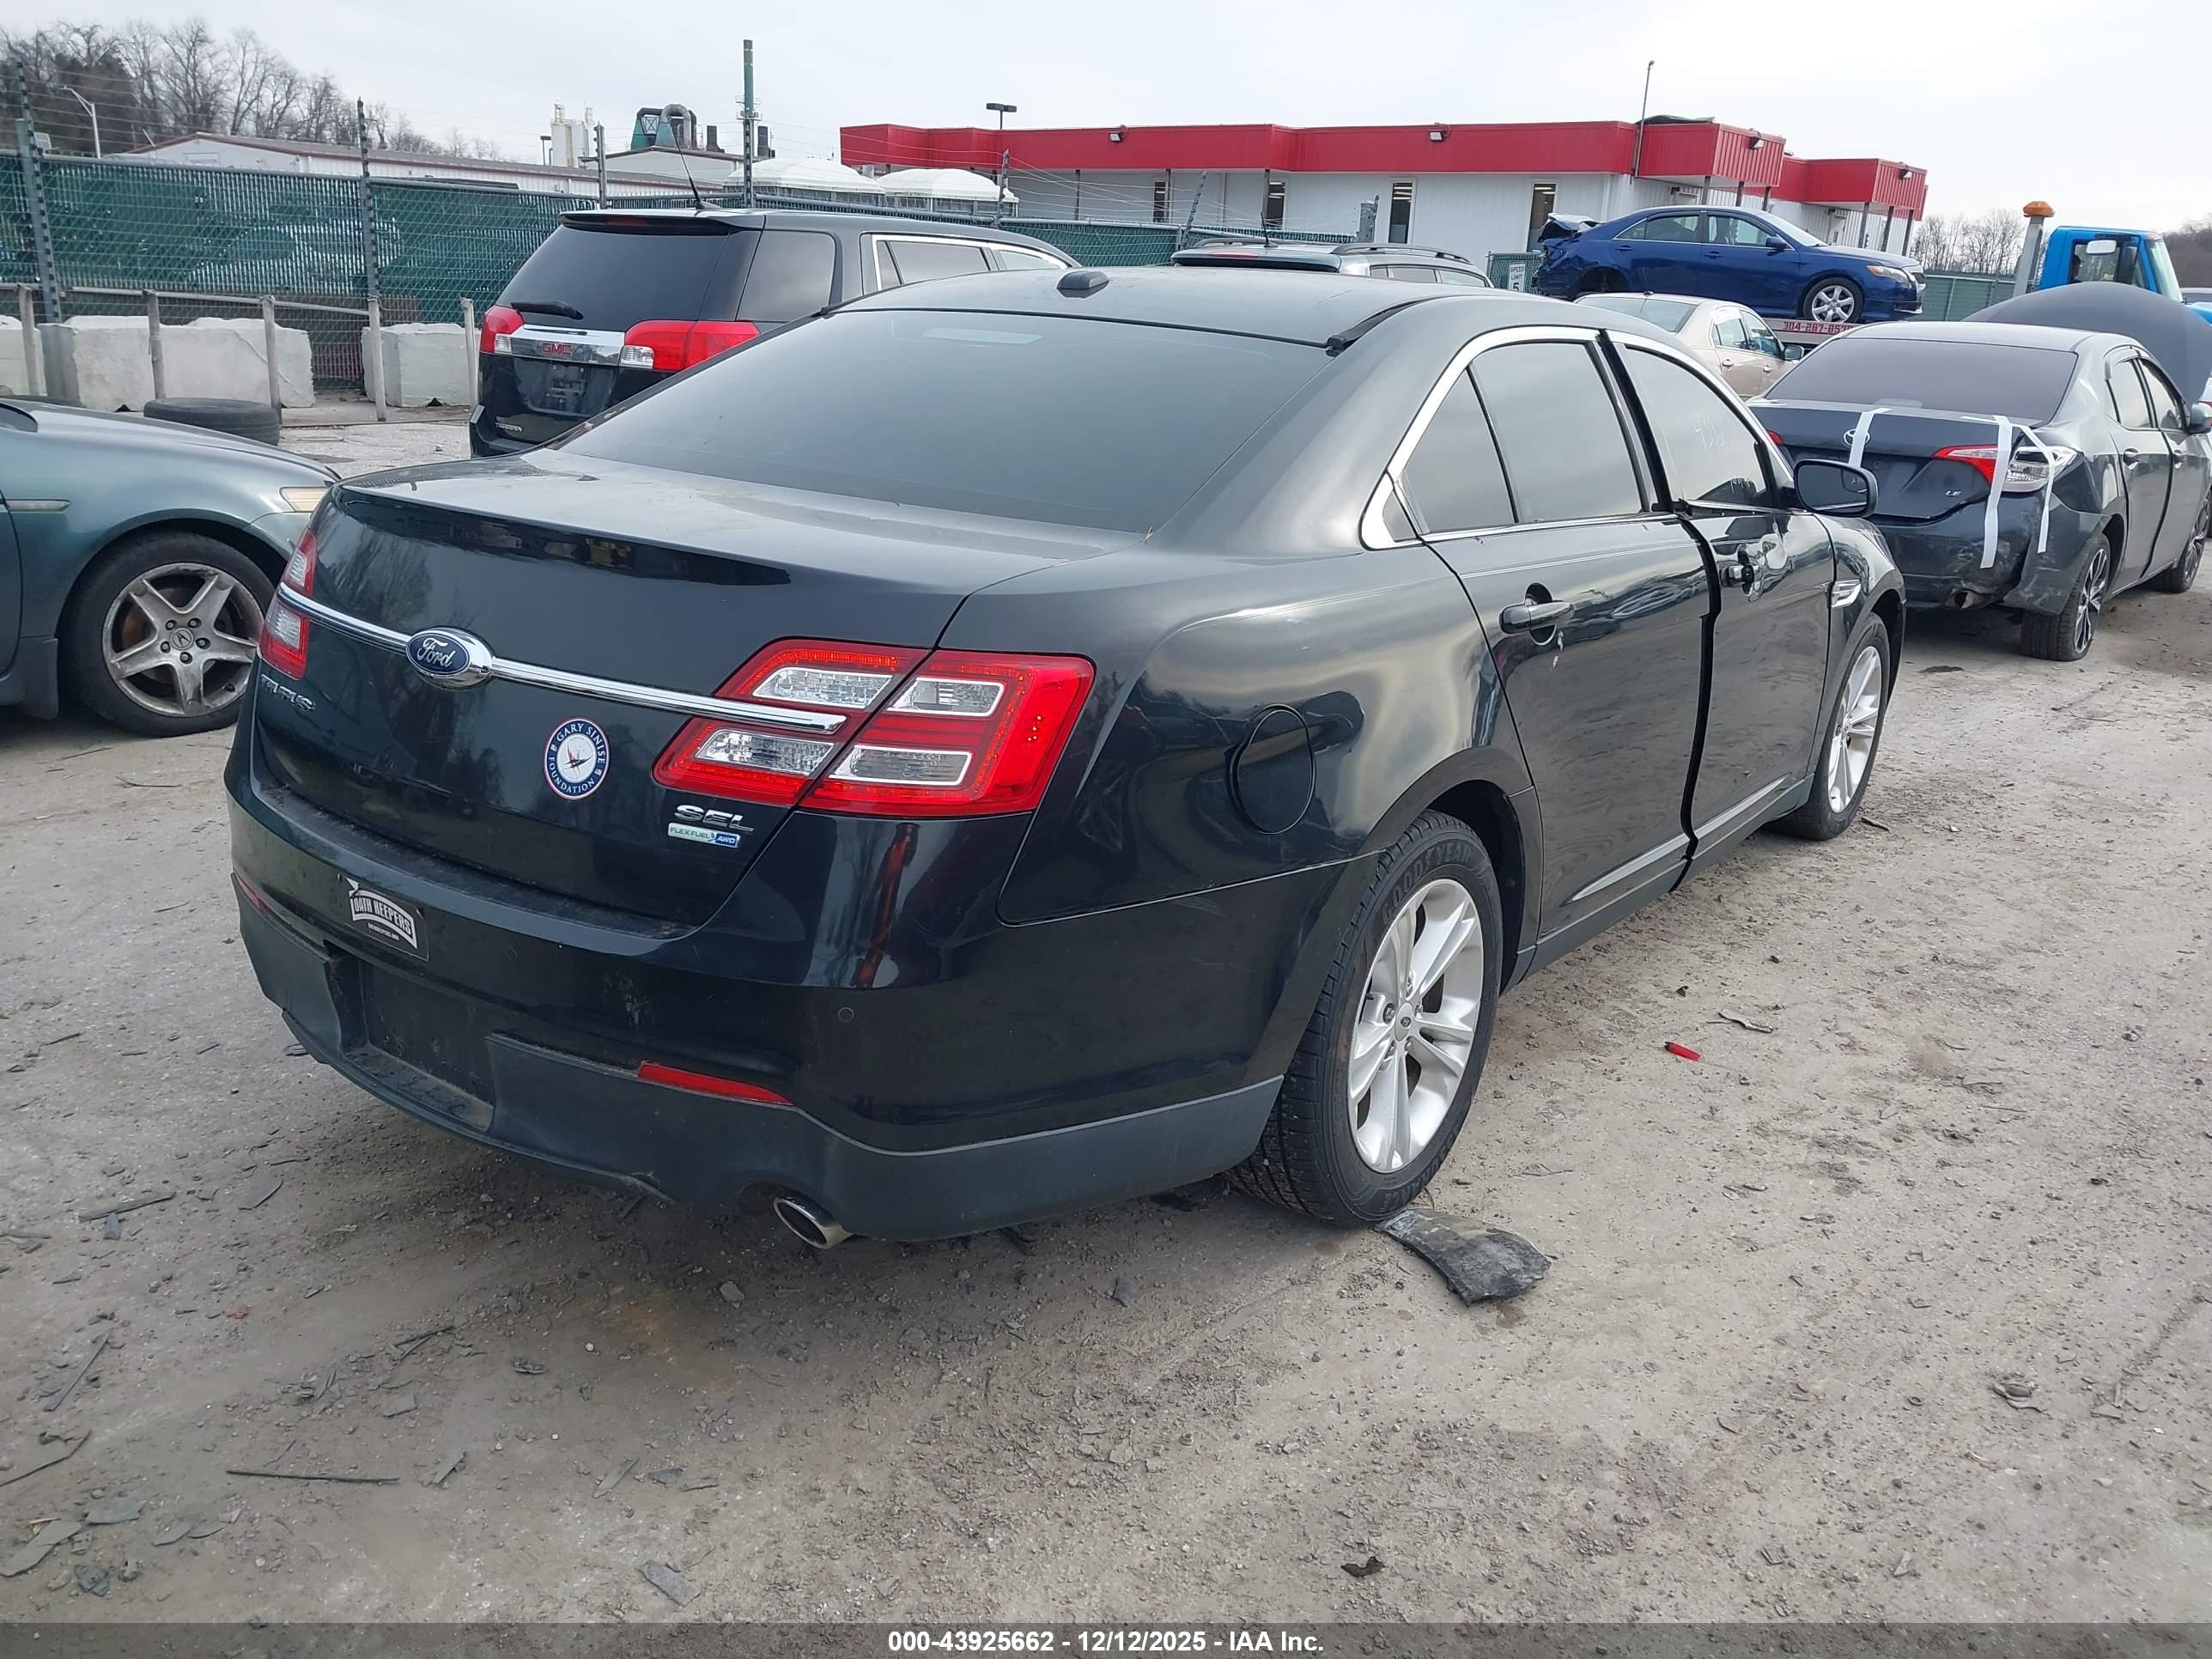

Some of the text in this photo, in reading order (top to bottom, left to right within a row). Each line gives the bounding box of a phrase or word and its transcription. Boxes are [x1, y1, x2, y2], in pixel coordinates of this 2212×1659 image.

[542, 343, 573, 355] GMC
[416, 637, 457, 667] Ford
[556, 722, 606, 764] GARY SINISE
[548, 757, 596, 793] FOUNDATION
[673, 805, 755, 832] SEL
[670, 827, 736, 844] FLEX FUEL AWD
[353, 897, 412, 935] OATH KEEPERS
